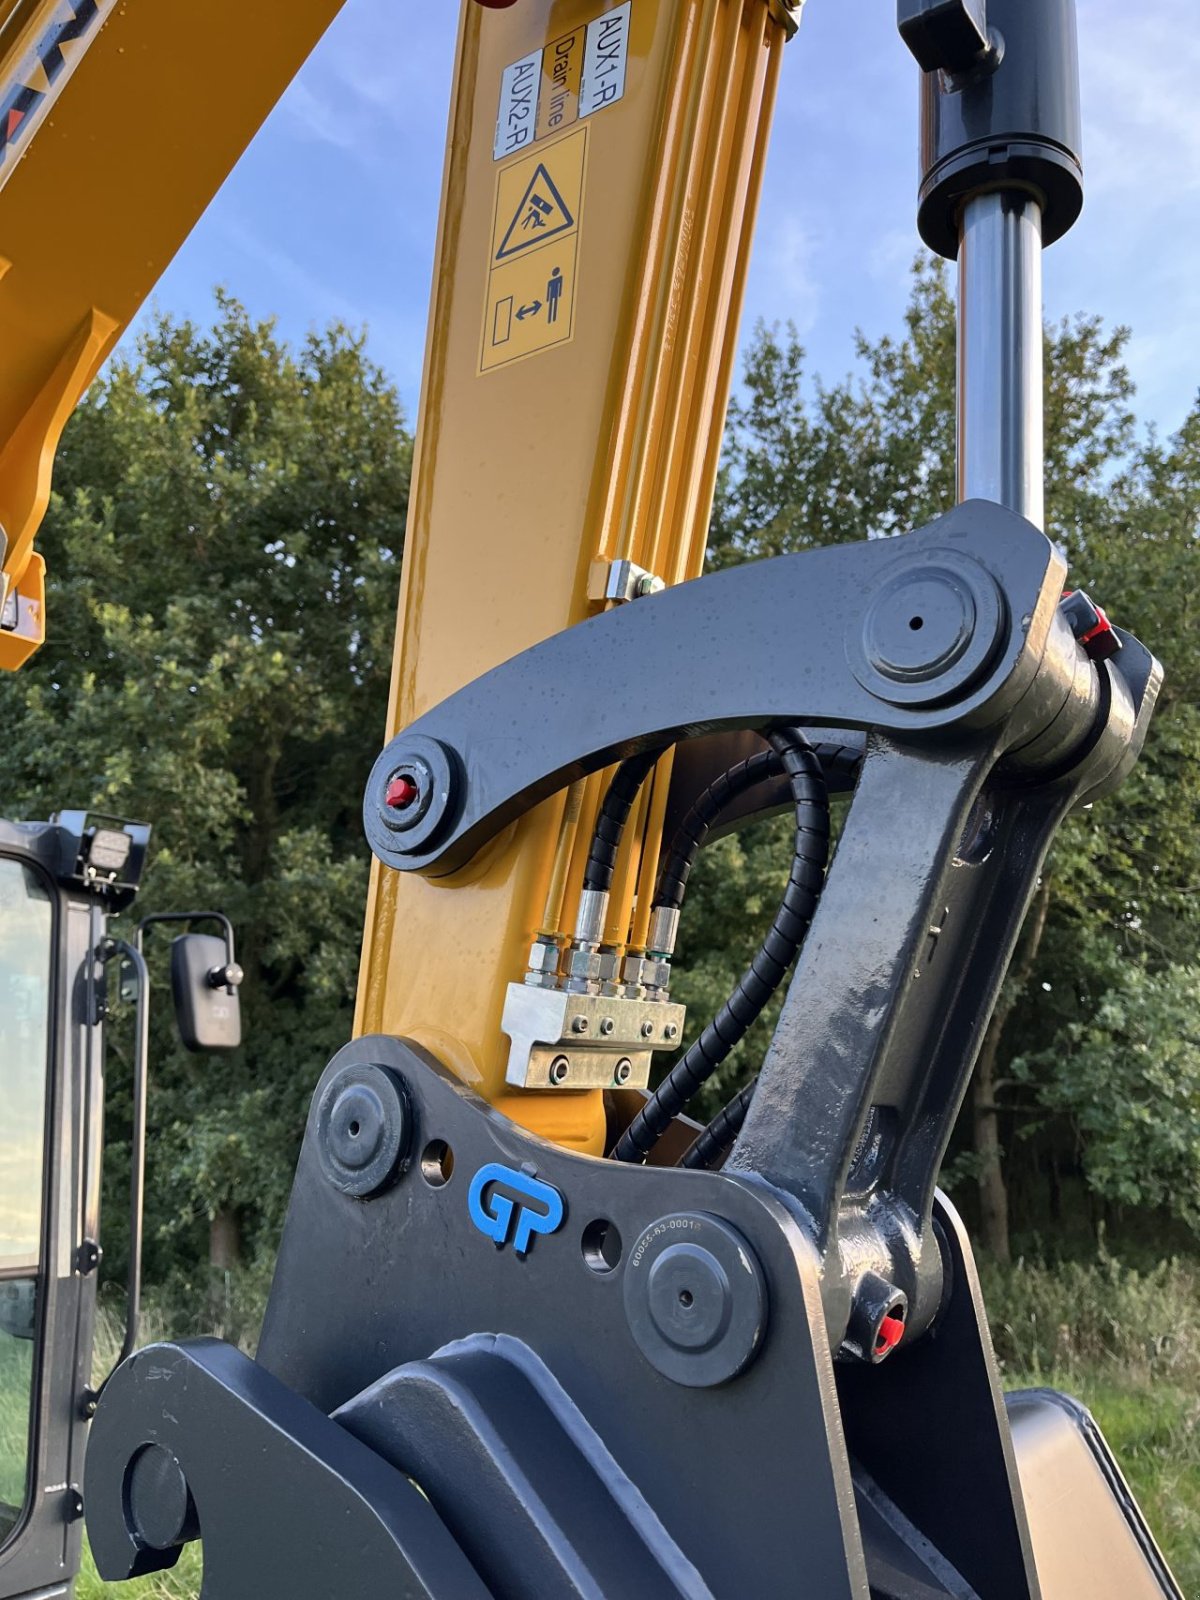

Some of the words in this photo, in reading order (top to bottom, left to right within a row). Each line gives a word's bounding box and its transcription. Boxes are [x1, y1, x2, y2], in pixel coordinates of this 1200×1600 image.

[551, 36, 575, 91] Drain
[592, 16, 623, 109] AUX1-R
[505, 62, 535, 150] AUX2-R
[548, 89, 571, 127] line
